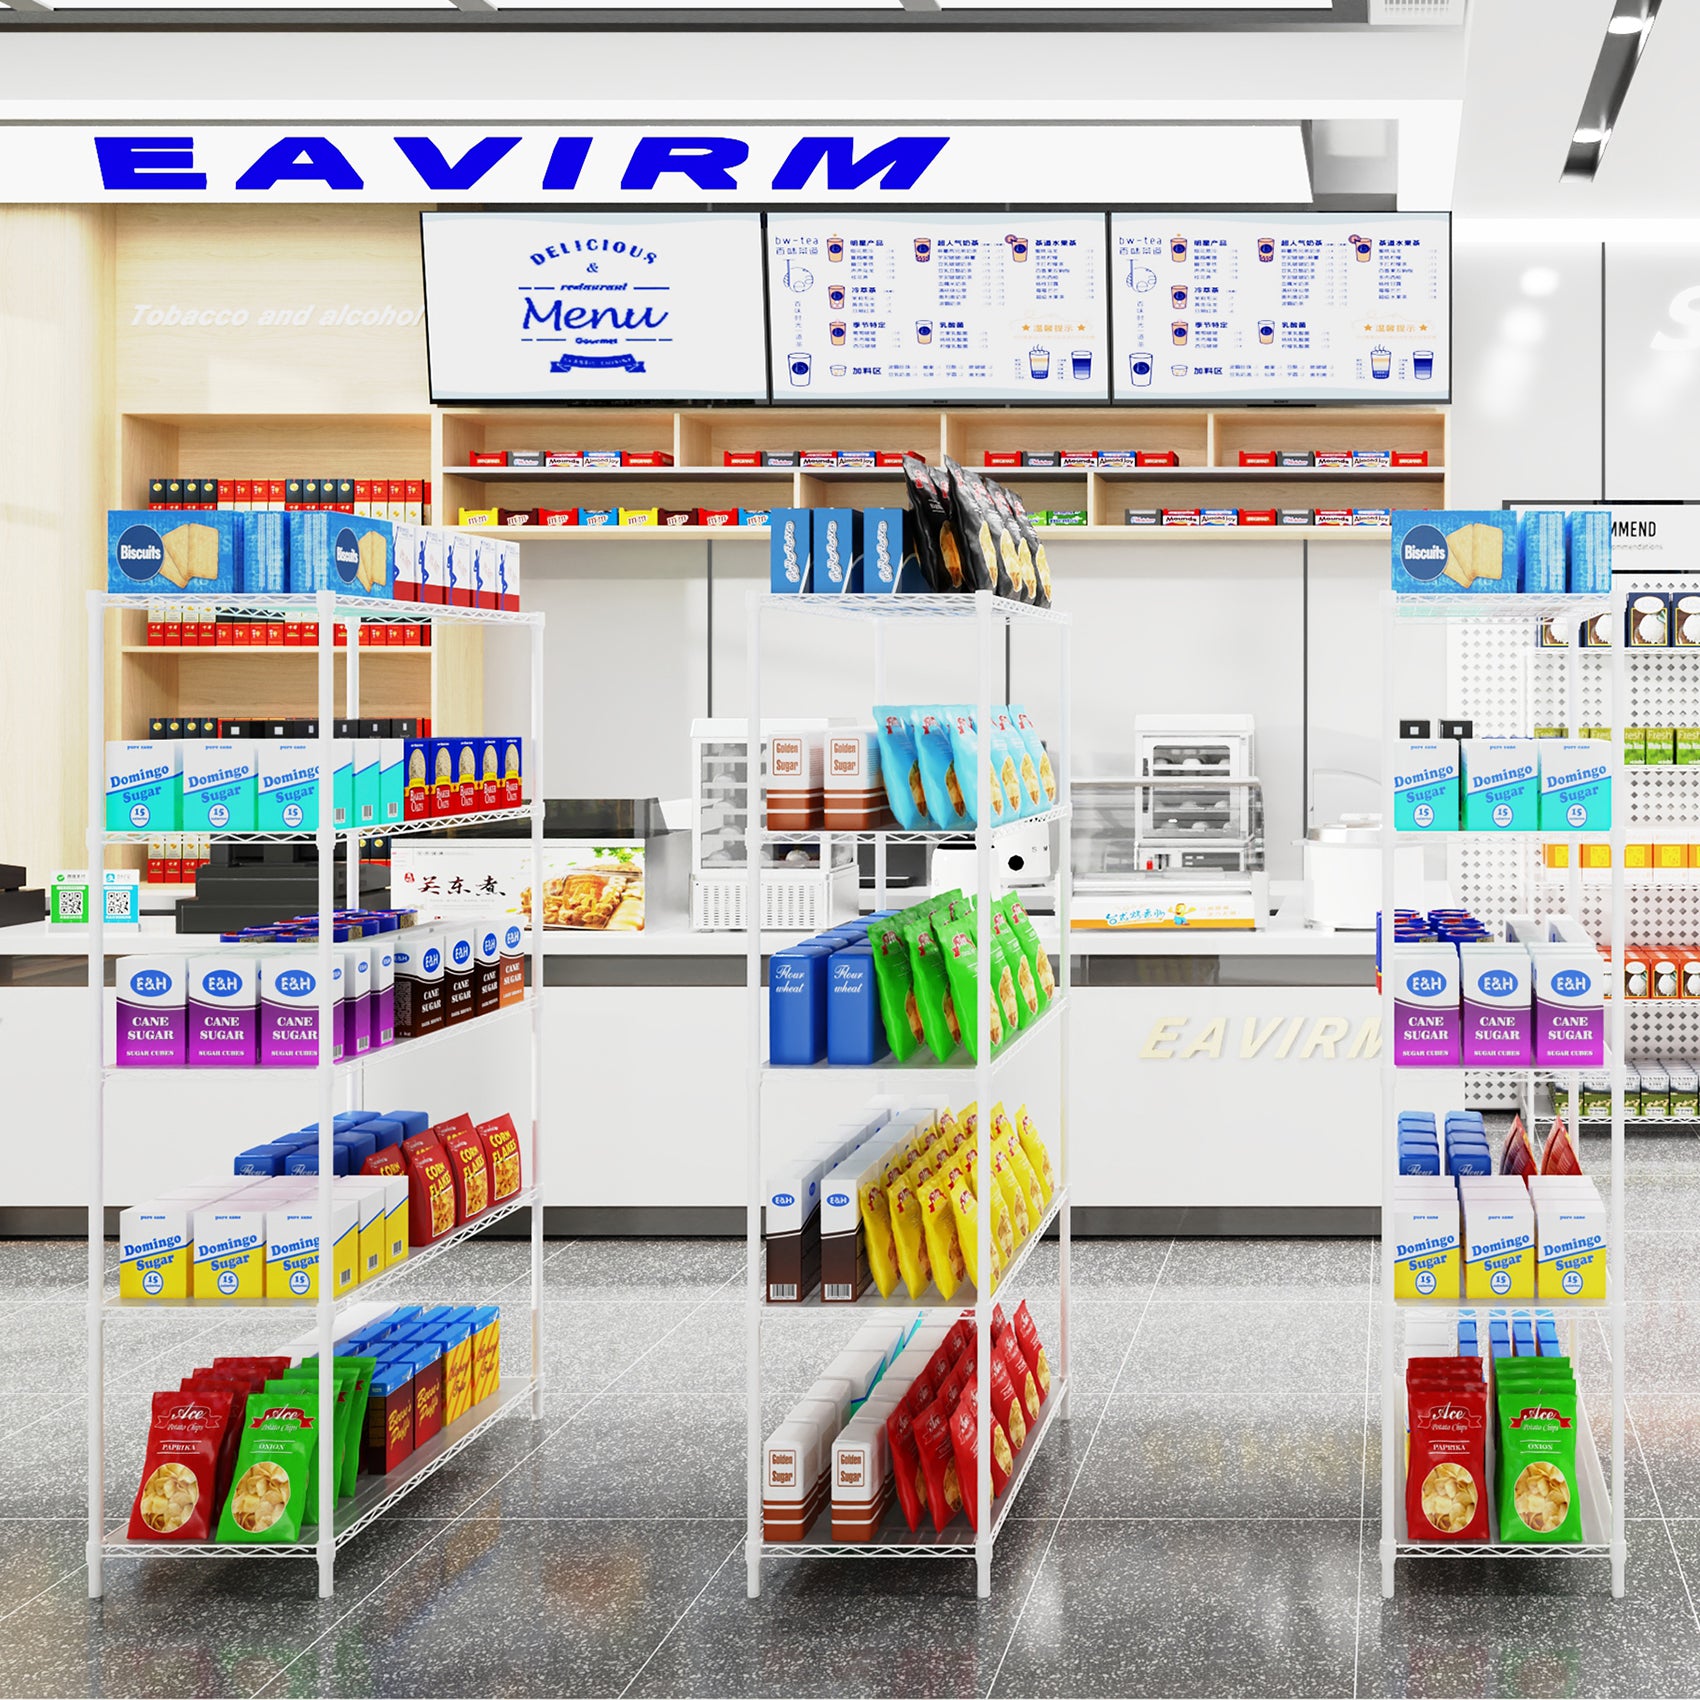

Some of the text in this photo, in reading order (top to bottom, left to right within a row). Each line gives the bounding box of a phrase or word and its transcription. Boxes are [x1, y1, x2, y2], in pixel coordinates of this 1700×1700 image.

[94, 137, 951, 191] EAVIRM
[529, 238, 658, 266] DELICIOUS
[586, 262, 599, 273] &
[560, 282, 628, 292] restaurant
[131, 304, 426, 326] Tobacco and alcohol
[522, 297, 669, 331] Menu
[853, 321, 886, 329] 季节特定
[1194, 321, 1228, 329] 季节特定
[852, 367, 882, 375] 加料区
[1193, 367, 1223, 375] 加料区
[120, 545, 162, 560] Biscuits
[336, 546, 359, 564] Biscuits
[1404, 545, 1446, 560] Biscuits
[1648, 729, 1674, 740] Fresh
[776, 743, 798, 753] Golden
[834, 743, 856, 753] Golden
[776, 760, 798, 772] Sugar
[834, 760, 856, 772] Sugar
[110, 765, 170, 788] Domingo
[188, 765, 250, 788] Domingo
[1394, 765, 1454, 788] Domingo
[1472, 765, 1533, 788] Domingo
[1547, 765, 1607, 788] Domingo
[123, 786, 162, 803] Sugar
[201, 786, 242, 803] Sugar
[276, 786, 315, 803] Sugar
[1406, 786, 1446, 803] Sugar
[1485, 786, 1526, 803] Sugar
[1559, 786, 1600, 803] Sugar
[134, 808, 145, 817] 15
[214, 808, 224, 817] 15
[1418, 808, 1430, 817] 15
[1497, 808, 1508, 817] 15
[418, 875, 506, 896] 关东煮
[506, 930, 520, 944] E&H
[484, 938, 496, 952] E&H
[454, 945, 469, 960] E&H
[425, 953, 440, 968] E&H
[505, 962, 520, 974] CANE
[776, 964, 804, 980] Flour
[834, 964, 863, 980] Flour
[136, 976, 167, 990] E&H
[208, 976, 238, 990] E&H
[280, 976, 310, 990] E&H
[483, 970, 496, 982] CANE
[504, 973, 522, 986] SUGAR
[1412, 976, 1442, 990] E&H
[1483, 976, 1513, 990] E&H
[1556, 976, 1586, 990] E&H
[453, 979, 470, 992] CANE
[482, 981, 498, 994] SUGAR
[776, 982, 804, 993] wheat
[834, 982, 862, 993] wheat
[424, 988, 440, 1000] CANE
[451, 990, 472, 1003] SUGAR
[422, 1000, 442, 1013] SUGAR
[132, 1016, 170, 1027] CANE
[204, 1016, 240, 1027] CANE
[276, 1016, 313, 1027] CANE
[1408, 1016, 1444, 1027] CANE
[1479, 1016, 1516, 1027] CANE
[1552, 1016, 1588, 1027] CANE
[128, 1030, 174, 1040] SUGAR
[200, 1030, 244, 1040] SUGAR
[272, 1030, 318, 1040] SUGAR
[1138, 1016, 1382, 1059] EAVIRM
[1404, 1030, 1448, 1040] SUGAR
[1475, 1030, 1520, 1040] SUGAR
[1548, 1030, 1593, 1040] SUGAR
[490, 1130, 512, 1148] CORN
[460, 1146, 478, 1163] CORN
[492, 1140, 516, 1163] FLAKES
[425, 1162, 446, 1180] CORN
[463, 1154, 484, 1178] FLAKES
[124, 1234, 182, 1256] Domingo
[198, 1234, 258, 1256] Domingo
[271, 1234, 319, 1256] Doming
[1396, 1234, 1454, 1256] Domingo
[1472, 1234, 1530, 1256] Domingo
[1543, 1234, 1602, 1256] Domingo
[136, 1254, 174, 1271] Sugar
[210, 1254, 250, 1271] Sugar
[283, 1254, 319, 1271] Sugar
[1409, 1254, 1448, 1271] Sugar
[1484, 1254, 1522, 1271] Sugar
[1556, 1254, 1594, 1271] Sugar
[148, 1276, 158, 1284] 15
[222, 1276, 234, 1284] 15
[1420, 1276, 1431, 1284] 15
[171, 1401, 205, 1420] Ace
[266, 1404, 299, 1420] Ace
[1432, 1402, 1466, 1420] Ace
[1523, 1404, 1556, 1420] Ace
[772, 1454, 793, 1465] Golden
[840, 1454, 862, 1465] Golden
[772, 1471, 793, 1483] Sugar
[840, 1471, 862, 1483] Sugar
